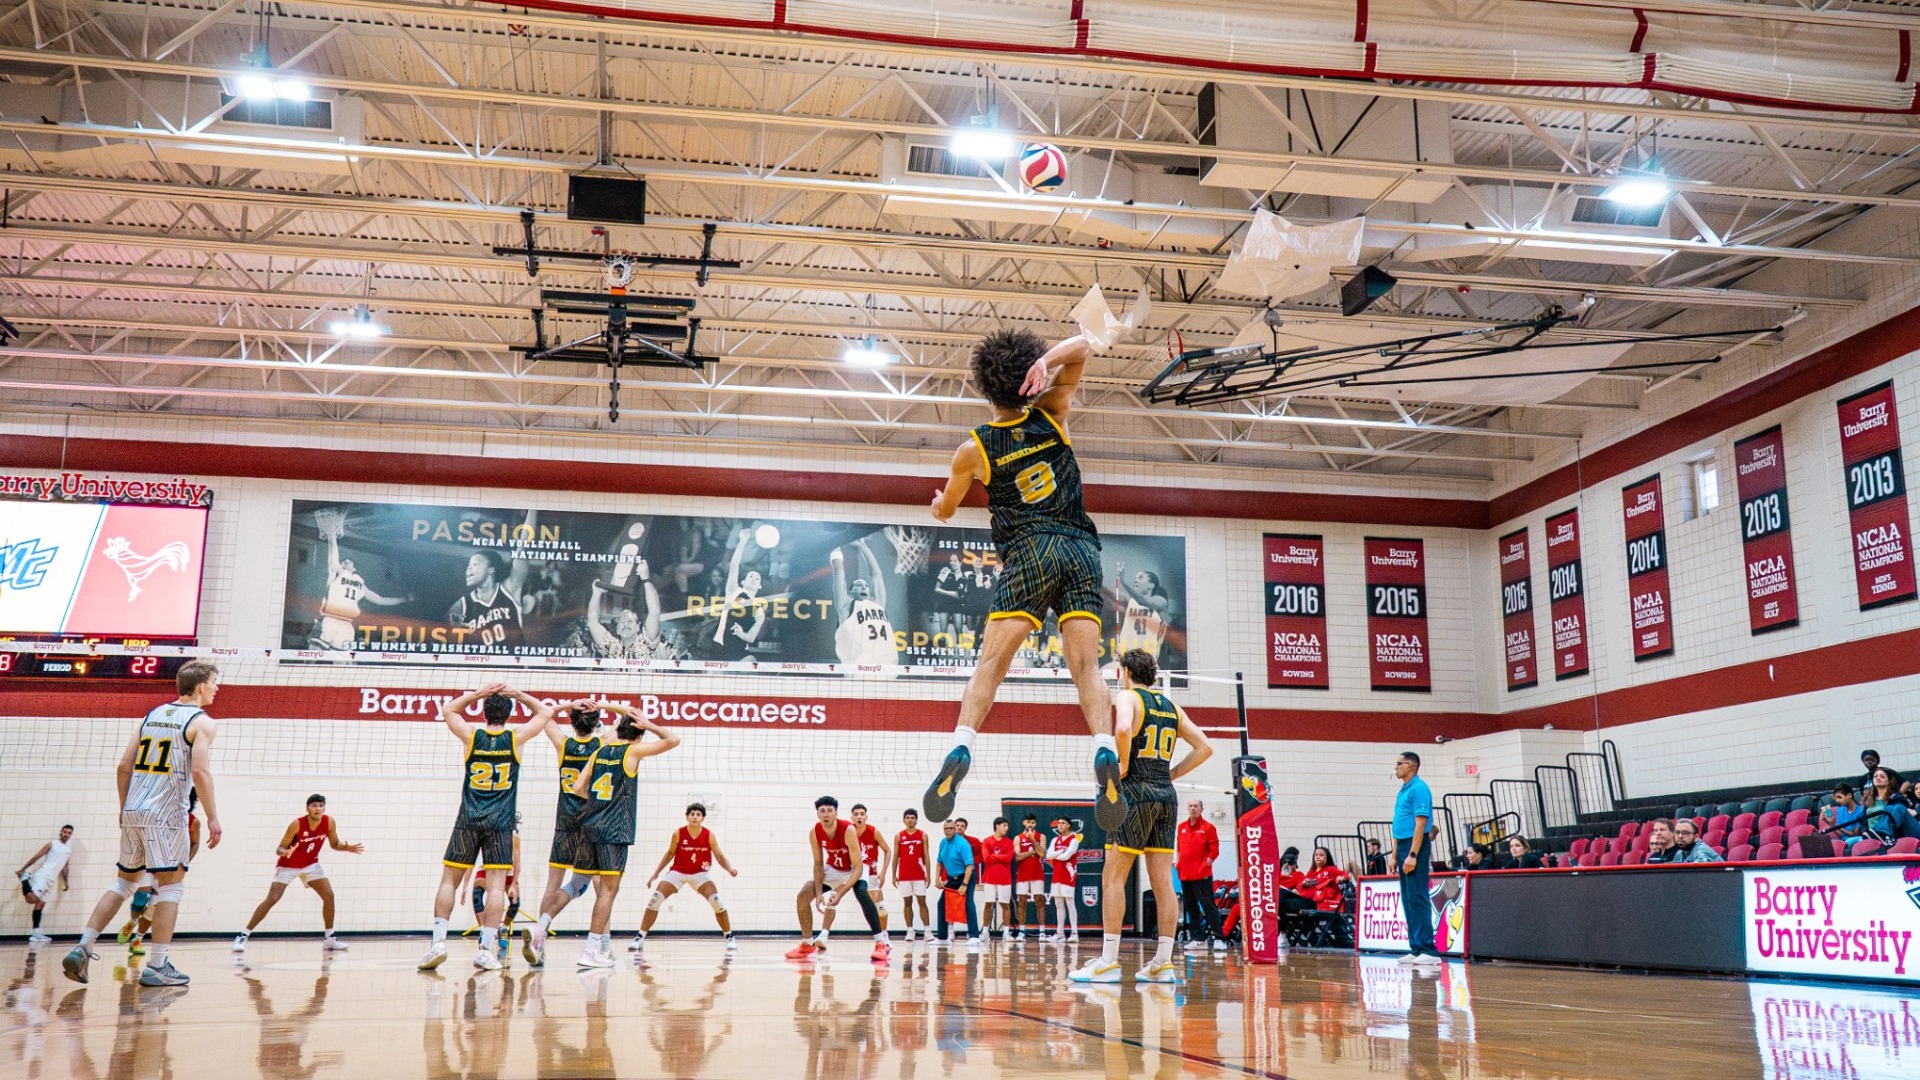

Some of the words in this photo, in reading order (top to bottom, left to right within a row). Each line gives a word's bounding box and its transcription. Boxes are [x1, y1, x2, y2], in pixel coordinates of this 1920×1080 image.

[1859, 402, 1886, 420] Barry
[1844, 411, 1888, 438] University
[1753, 444, 1775, 460] Barry
[1740, 454, 1776, 475] University
[0, 475, 58, 500] arry
[61, 473, 207, 506] University
[1015, 461, 1057, 504] 8
[1851, 456, 1894, 505] 2013
[1637, 491, 1655, 504] Barry
[1627, 500, 1656, 518] University
[1745, 493, 1781, 538] 2013
[412, 519, 560, 544] PASSION
[1857, 522, 1901, 549] NCAA
[472, 537, 503, 547] NCAA
[509, 539, 581, 550] VOLLEYBALL
[939, 540, 959, 550] SSC
[963, 541, 996, 551] VOLLE
[1289, 546, 1317, 558] Barry
[1859, 540, 1903, 562] NATIONAL
[511, 550, 569, 561] NATIONAL
[575, 552, 642, 564] CHAMPIONS
[962, 548, 998, 566] SE
[1271, 554, 1319, 566] University
[1371, 556, 1418, 568] University
[1389, 548, 1416, 560] Barry
[1629, 535, 1660, 574] 2014
[1859, 551, 1904, 571] CHAMPIONS
[1749, 555, 1786, 579] NCAA
[1552, 563, 1577, 599] 2014
[1751, 571, 1787, 590] NATIONAL
[1871, 580, 1897, 595] TENNIS
[344, 588, 356, 600] 11
[1504, 581, 1527, 615] 2015
[1751, 581, 1788, 599] CHAMPIONS
[686, 595, 833, 620] RESPECT
[1273, 585, 1319, 614] 2016
[1375, 587, 1419, 615] 2015
[1633, 591, 1663, 611] NCAA
[469, 607, 511, 633] BARRY
[1634, 606, 1664, 621] NATIONAL
[1764, 607, 1780, 619] GOLF
[868, 624, 887, 641] 34
[1554, 615, 1579, 633] NCAA
[358, 626, 470, 647] TRUST
[481, 624, 505, 646] 00
[1274, 633, 1320, 647] NCAA
[1376, 634, 1422, 647] NCAA
[1506, 630, 1529, 647] NCAA
[342, 641, 366, 651] SSC
[370, 642, 427, 653] WOMEN'S
[432, 643, 509, 655] BASKETBALL
[514, 646, 583, 657] CHAMPIONS
[906, 646, 926, 655] SSC
[931, 647, 965, 656] MEN'S
[1274, 646, 1321, 655] NATIONAL
[1377, 648, 1423, 656] NATIONAL
[131, 656, 157, 674] 22
[917, 658, 980, 667] CHAMPIONS
[1274, 654, 1322, 663] CHAMPIONS
[1376, 656, 1424, 664] CHAMPIONS
[43, 663, 72, 672] PERIOD
[75, 662, 86, 674] 4
[1282, 670, 1314, 678] ROWING
[1385, 671, 1416, 679] ROWING
[359, 688, 453, 721] Barry
[640, 694, 827, 724] Buccaneers
[1137, 724, 1177, 762] 10
[133, 736, 173, 776] 11
[469, 762, 512, 791] 21
[561, 767, 581, 794] 2
[592, 773, 613, 801] 4
[908, 845, 914, 855] 2
[1246, 825, 1265, 952] Buccaneers
[1262, 863, 1276, 913] BarryU
[1364, 886, 1400, 918] Barry
[1754, 877, 1837, 926] Barry
[1363, 914, 1409, 941] Univers
[1755, 919, 1912, 974] University
